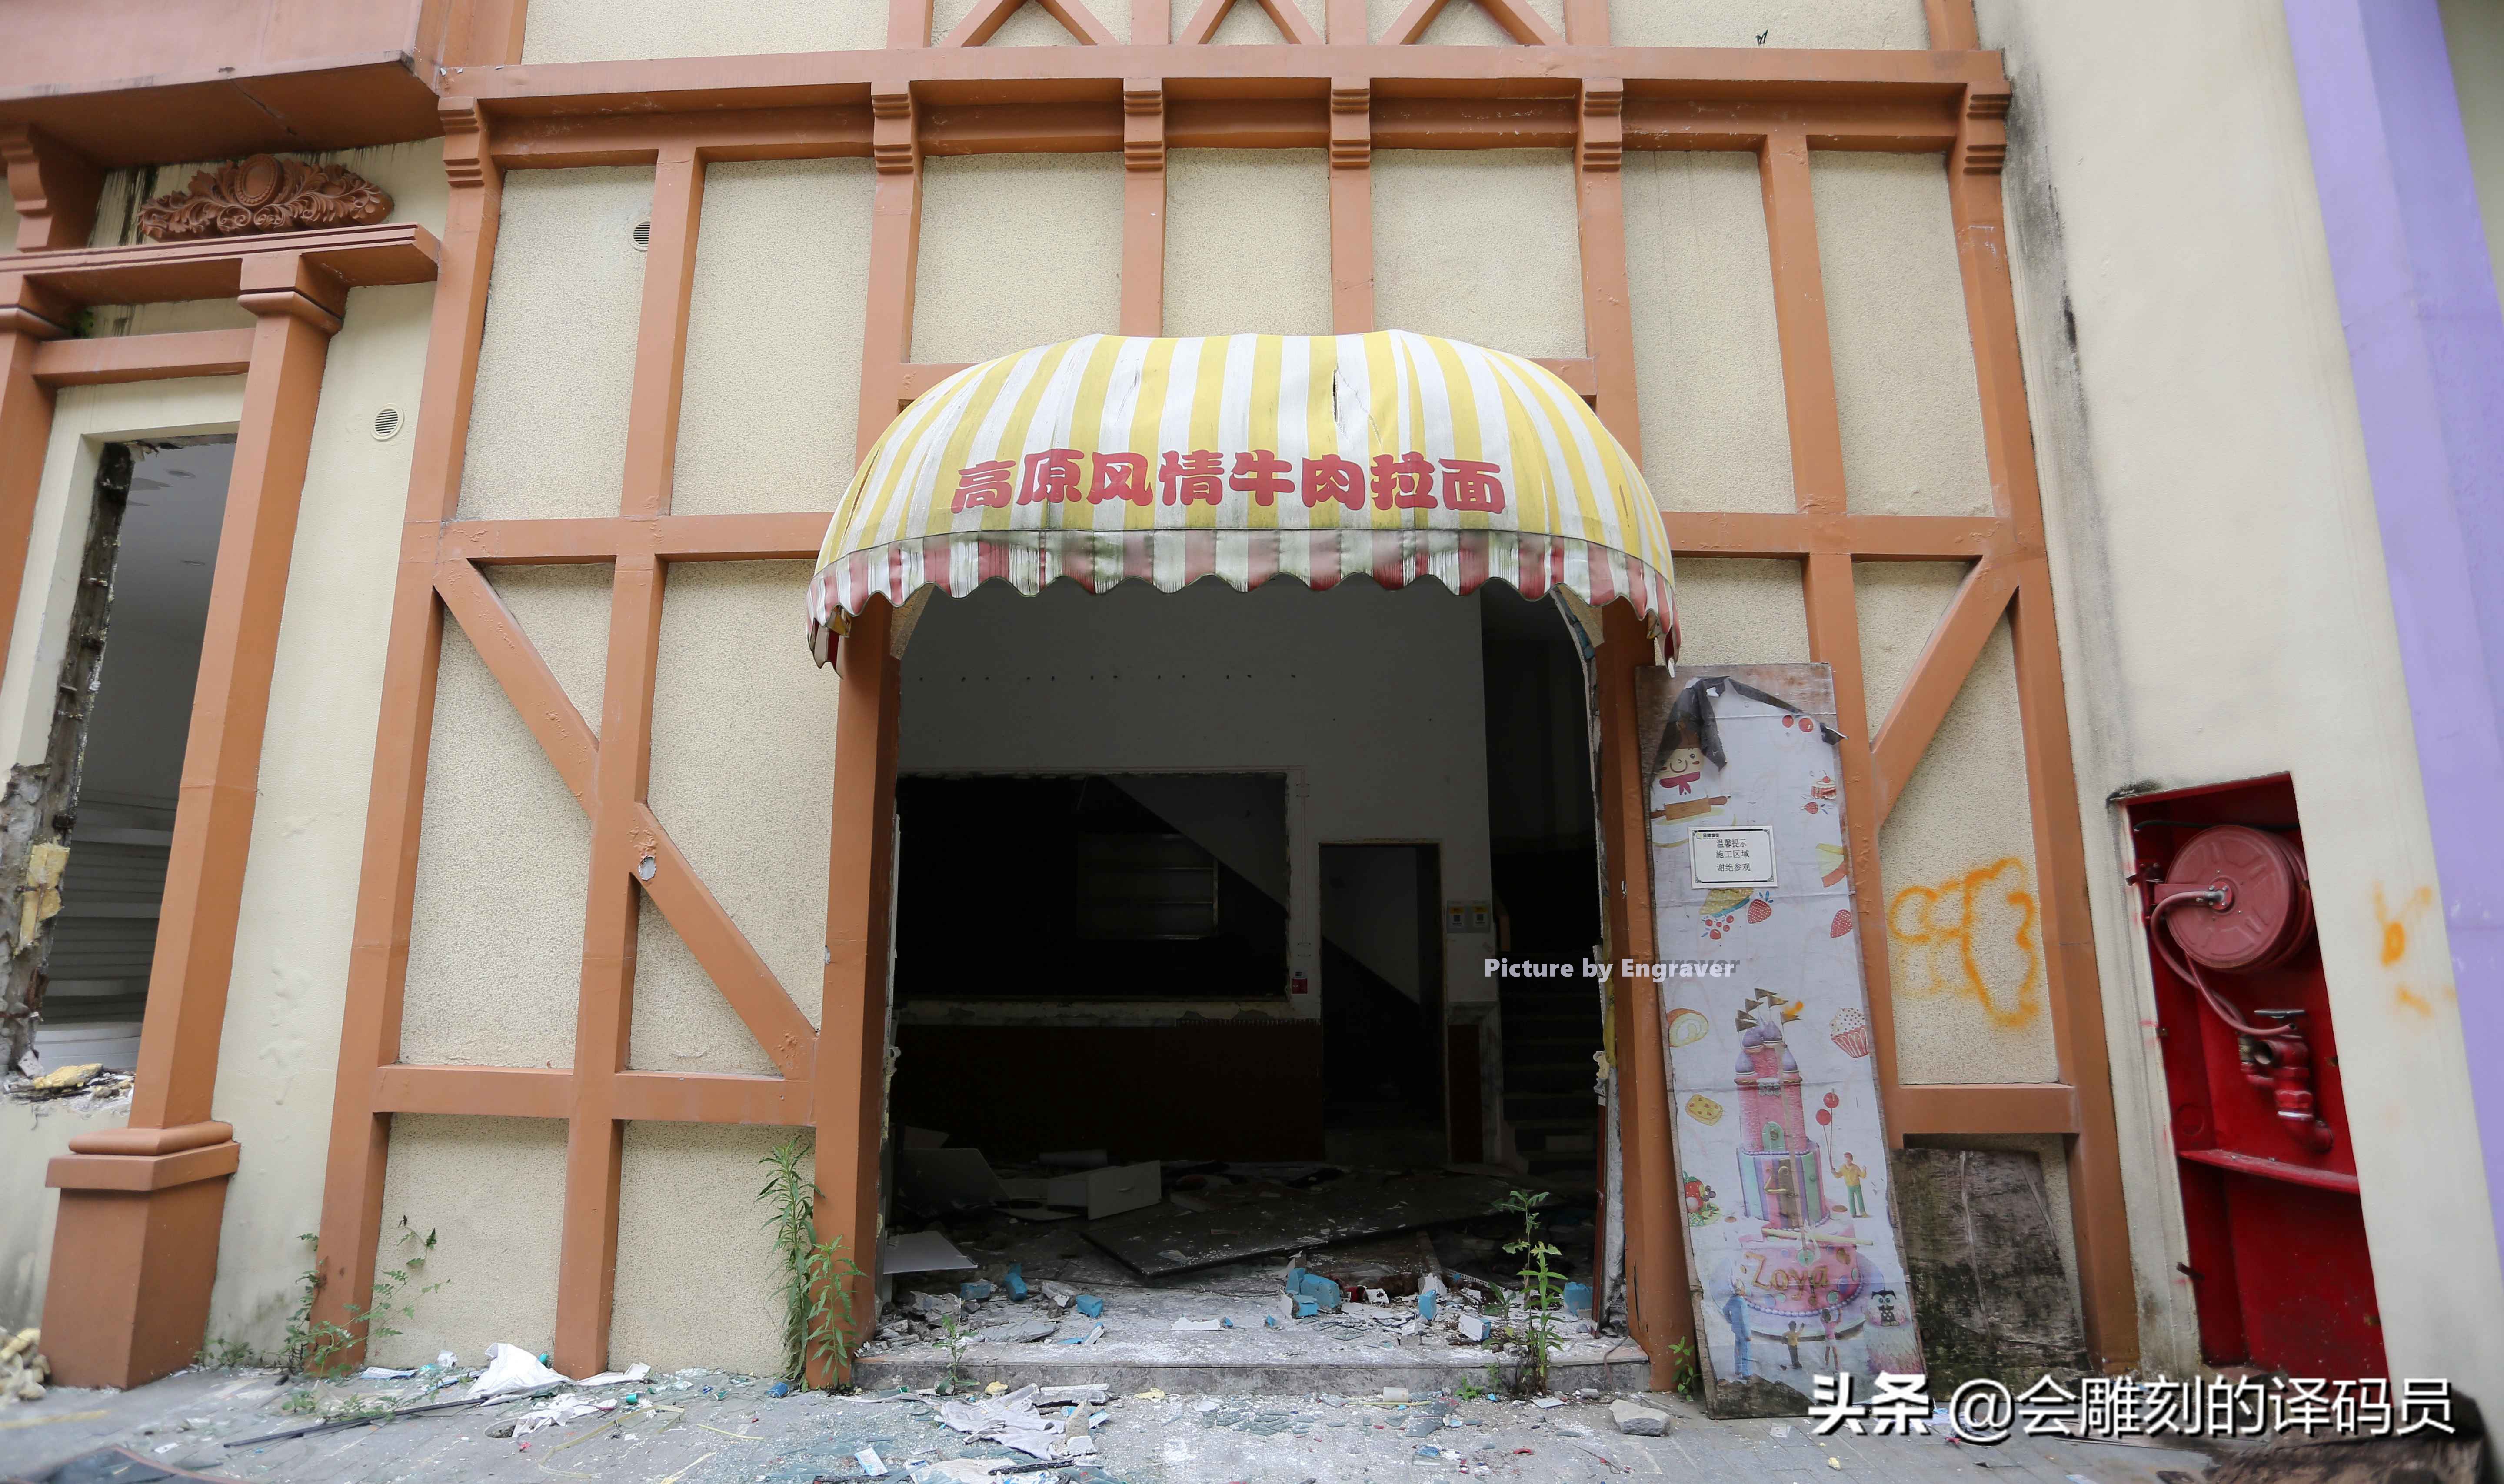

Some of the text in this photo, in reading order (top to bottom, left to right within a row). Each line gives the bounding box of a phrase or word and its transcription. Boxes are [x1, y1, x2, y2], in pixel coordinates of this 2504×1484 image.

[951, 449, 1507, 514] 高原风情牛肉拉面
[1716, 838, 1747, 848] 温馨提示
[1715, 850, 1750, 858] 施工区域
[1717, 863, 1751, 872] 谢绝参观
